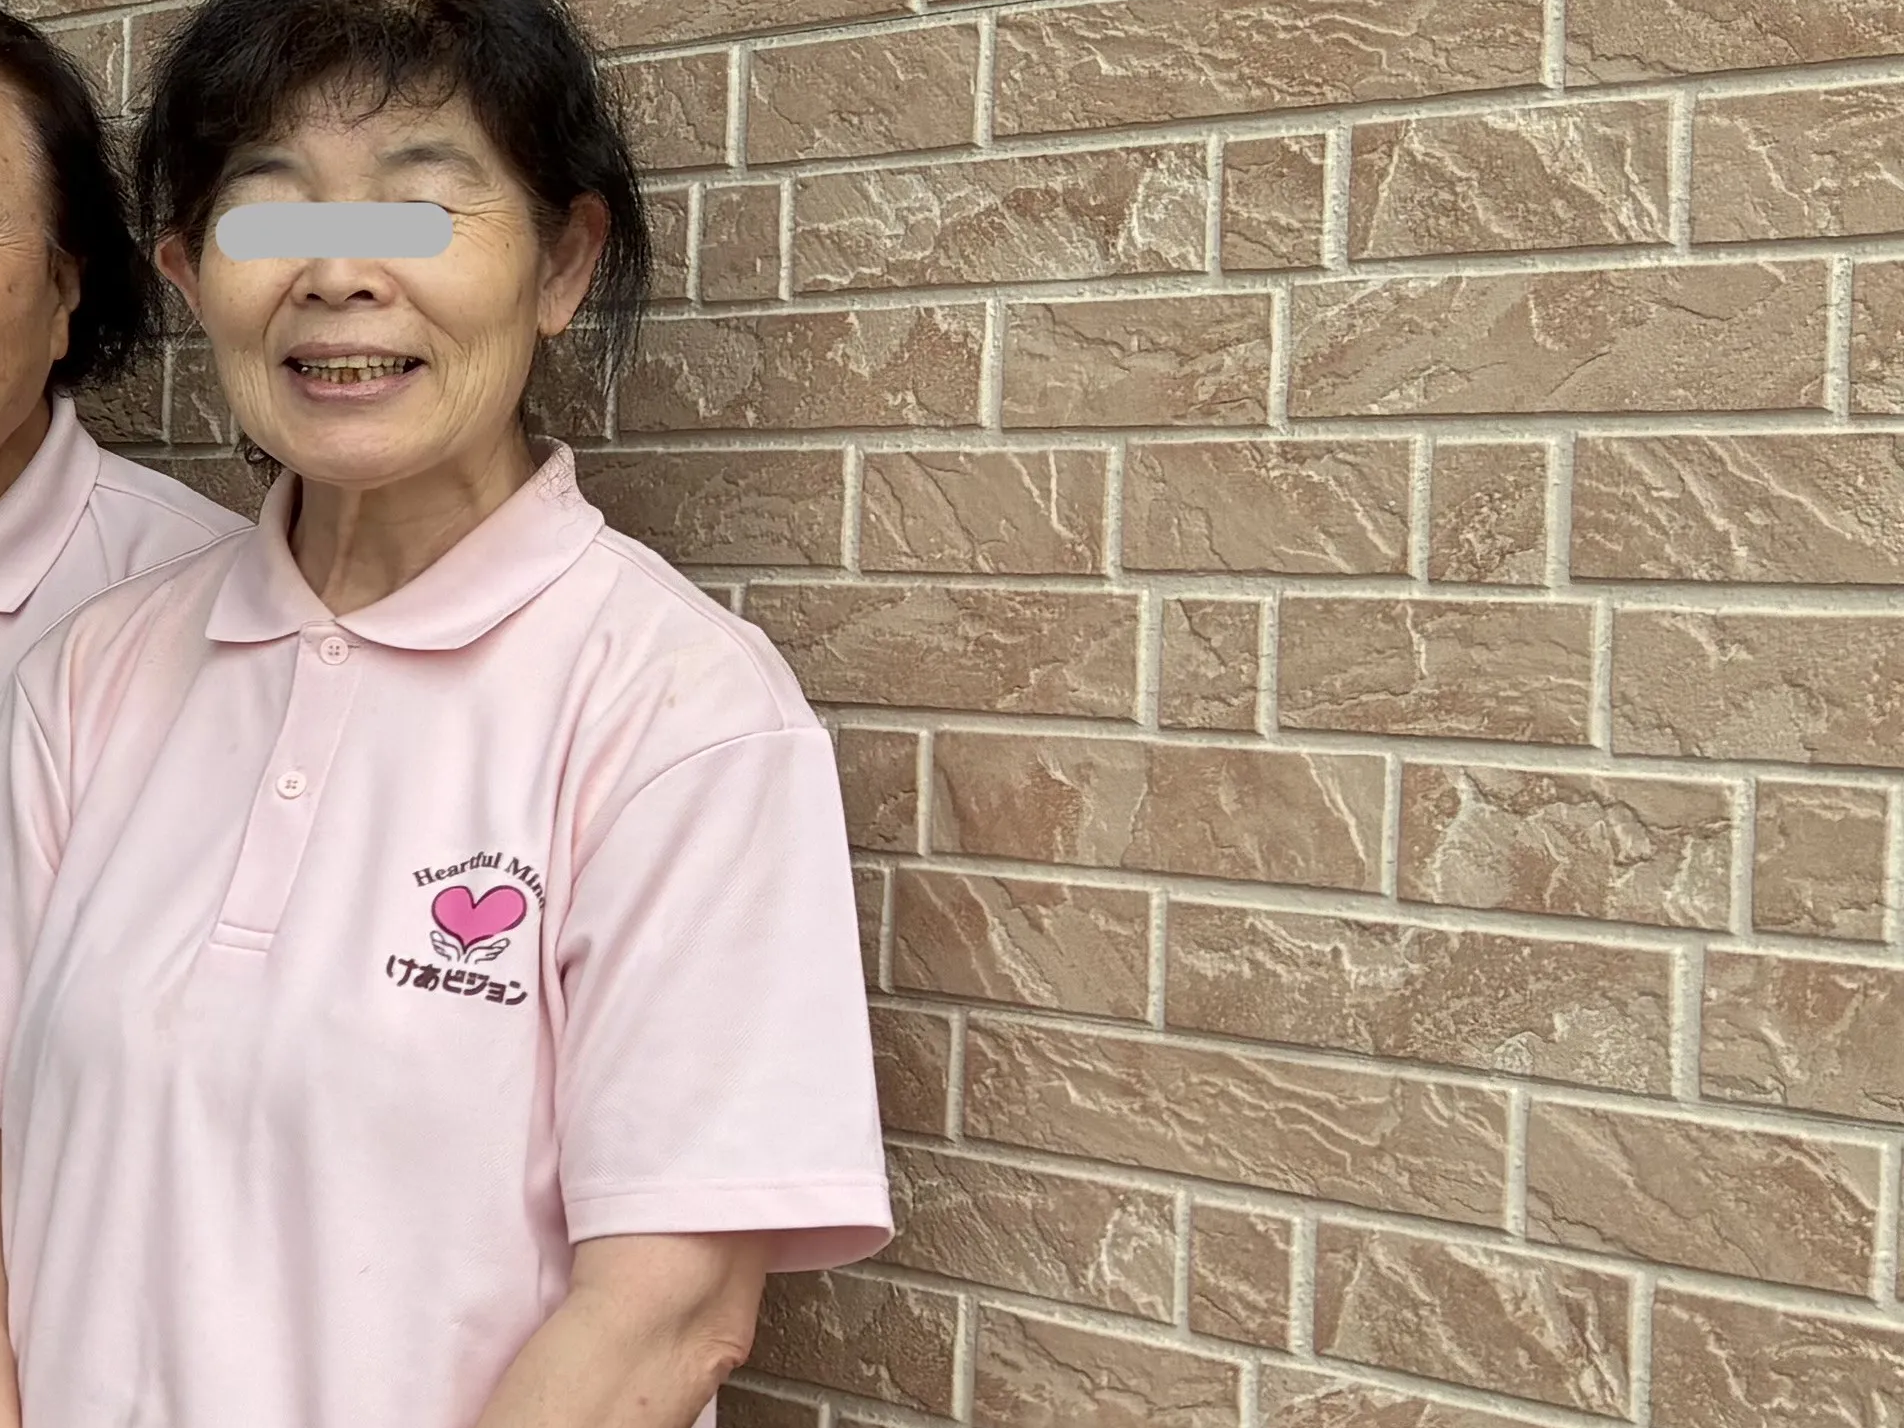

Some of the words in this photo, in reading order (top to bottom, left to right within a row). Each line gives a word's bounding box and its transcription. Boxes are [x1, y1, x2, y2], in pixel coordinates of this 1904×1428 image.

[412, 851, 503, 887] Heartful
[386, 954, 527, 1005] けあビジョン
